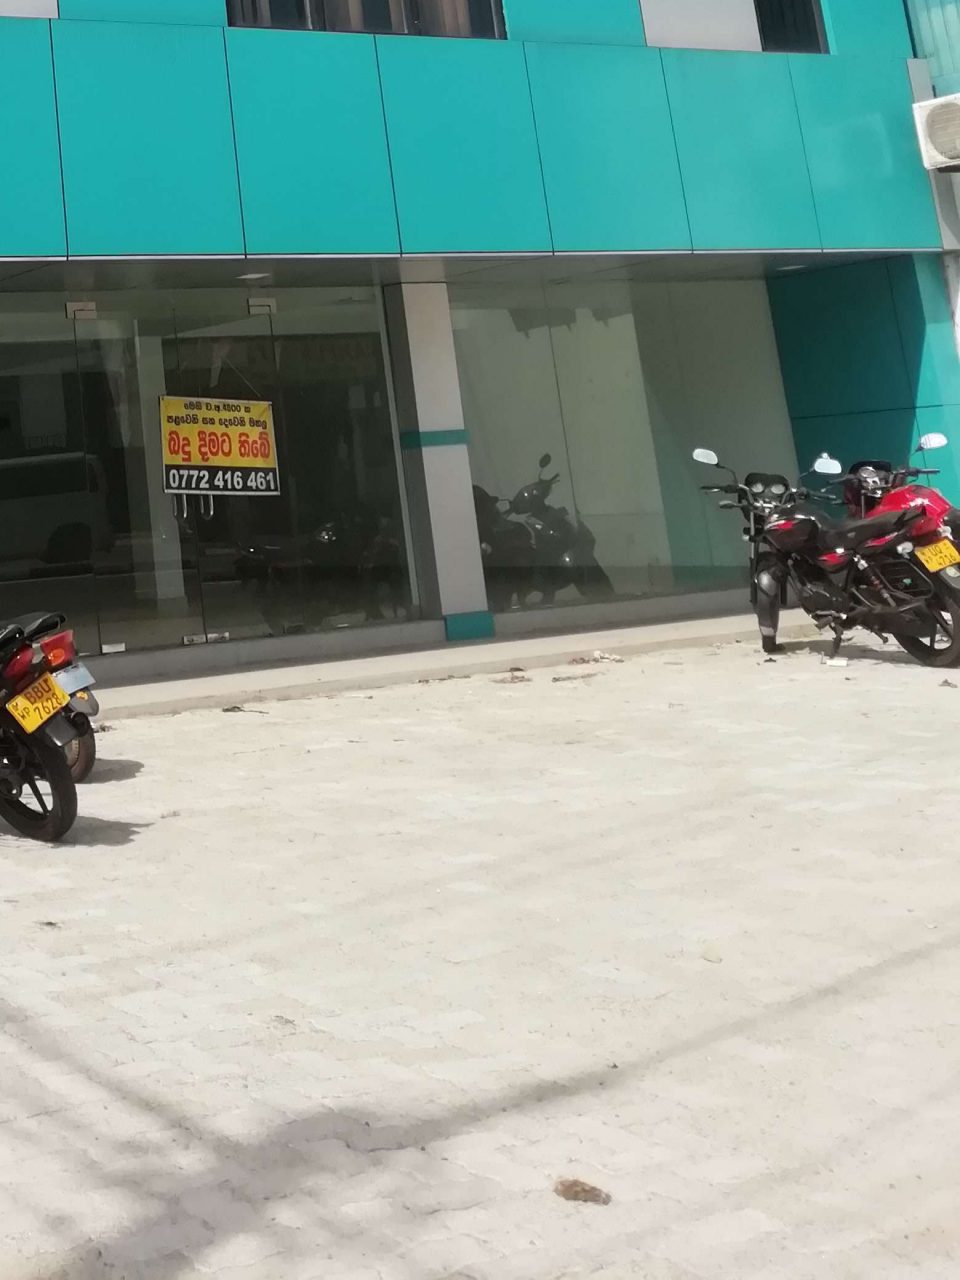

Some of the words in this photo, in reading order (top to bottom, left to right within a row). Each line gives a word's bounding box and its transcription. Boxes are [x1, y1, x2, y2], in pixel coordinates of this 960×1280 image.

[167, 430, 192, 463] බදු
[197, 430, 232, 463] දීමට
[238, 431, 271, 461] තිබේ
[169, 469, 210, 489] 0772
[214, 470, 243, 490] 416
[247, 471, 275, 490] 461
[24, 678, 52, 705] BBU
[17, 706, 31, 721] WP
[33, 692, 63, 721] 7628
